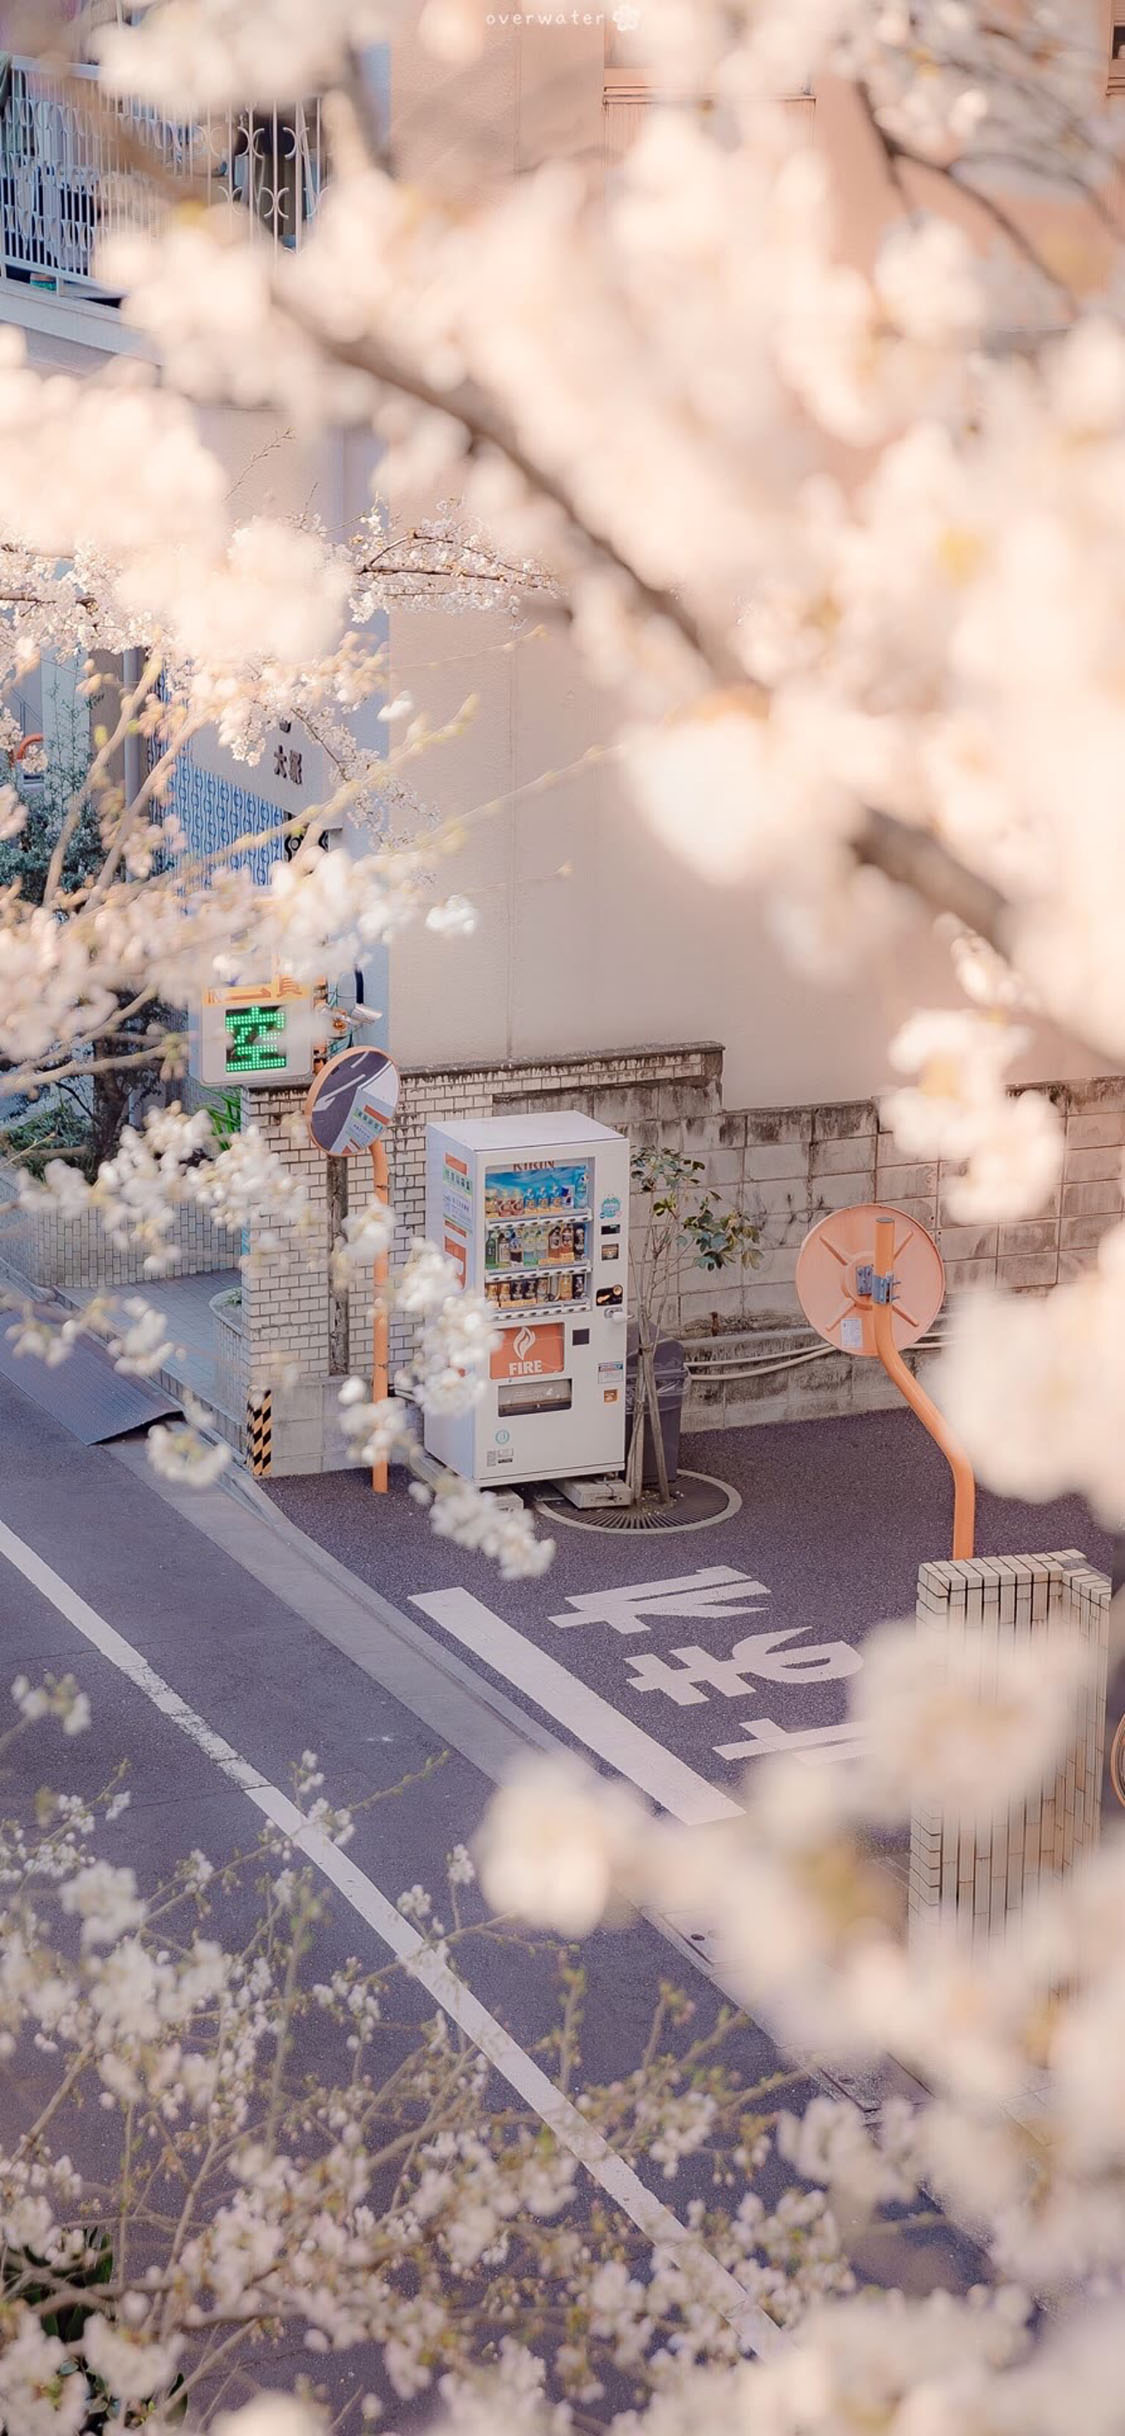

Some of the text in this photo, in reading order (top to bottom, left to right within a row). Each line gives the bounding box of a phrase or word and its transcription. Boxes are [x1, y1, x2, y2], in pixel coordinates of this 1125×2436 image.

[225, 1006, 285, 1070] 空
[513, 1160, 555, 1172] KIRIN
[508, 1359, 543, 1377] FIRE
